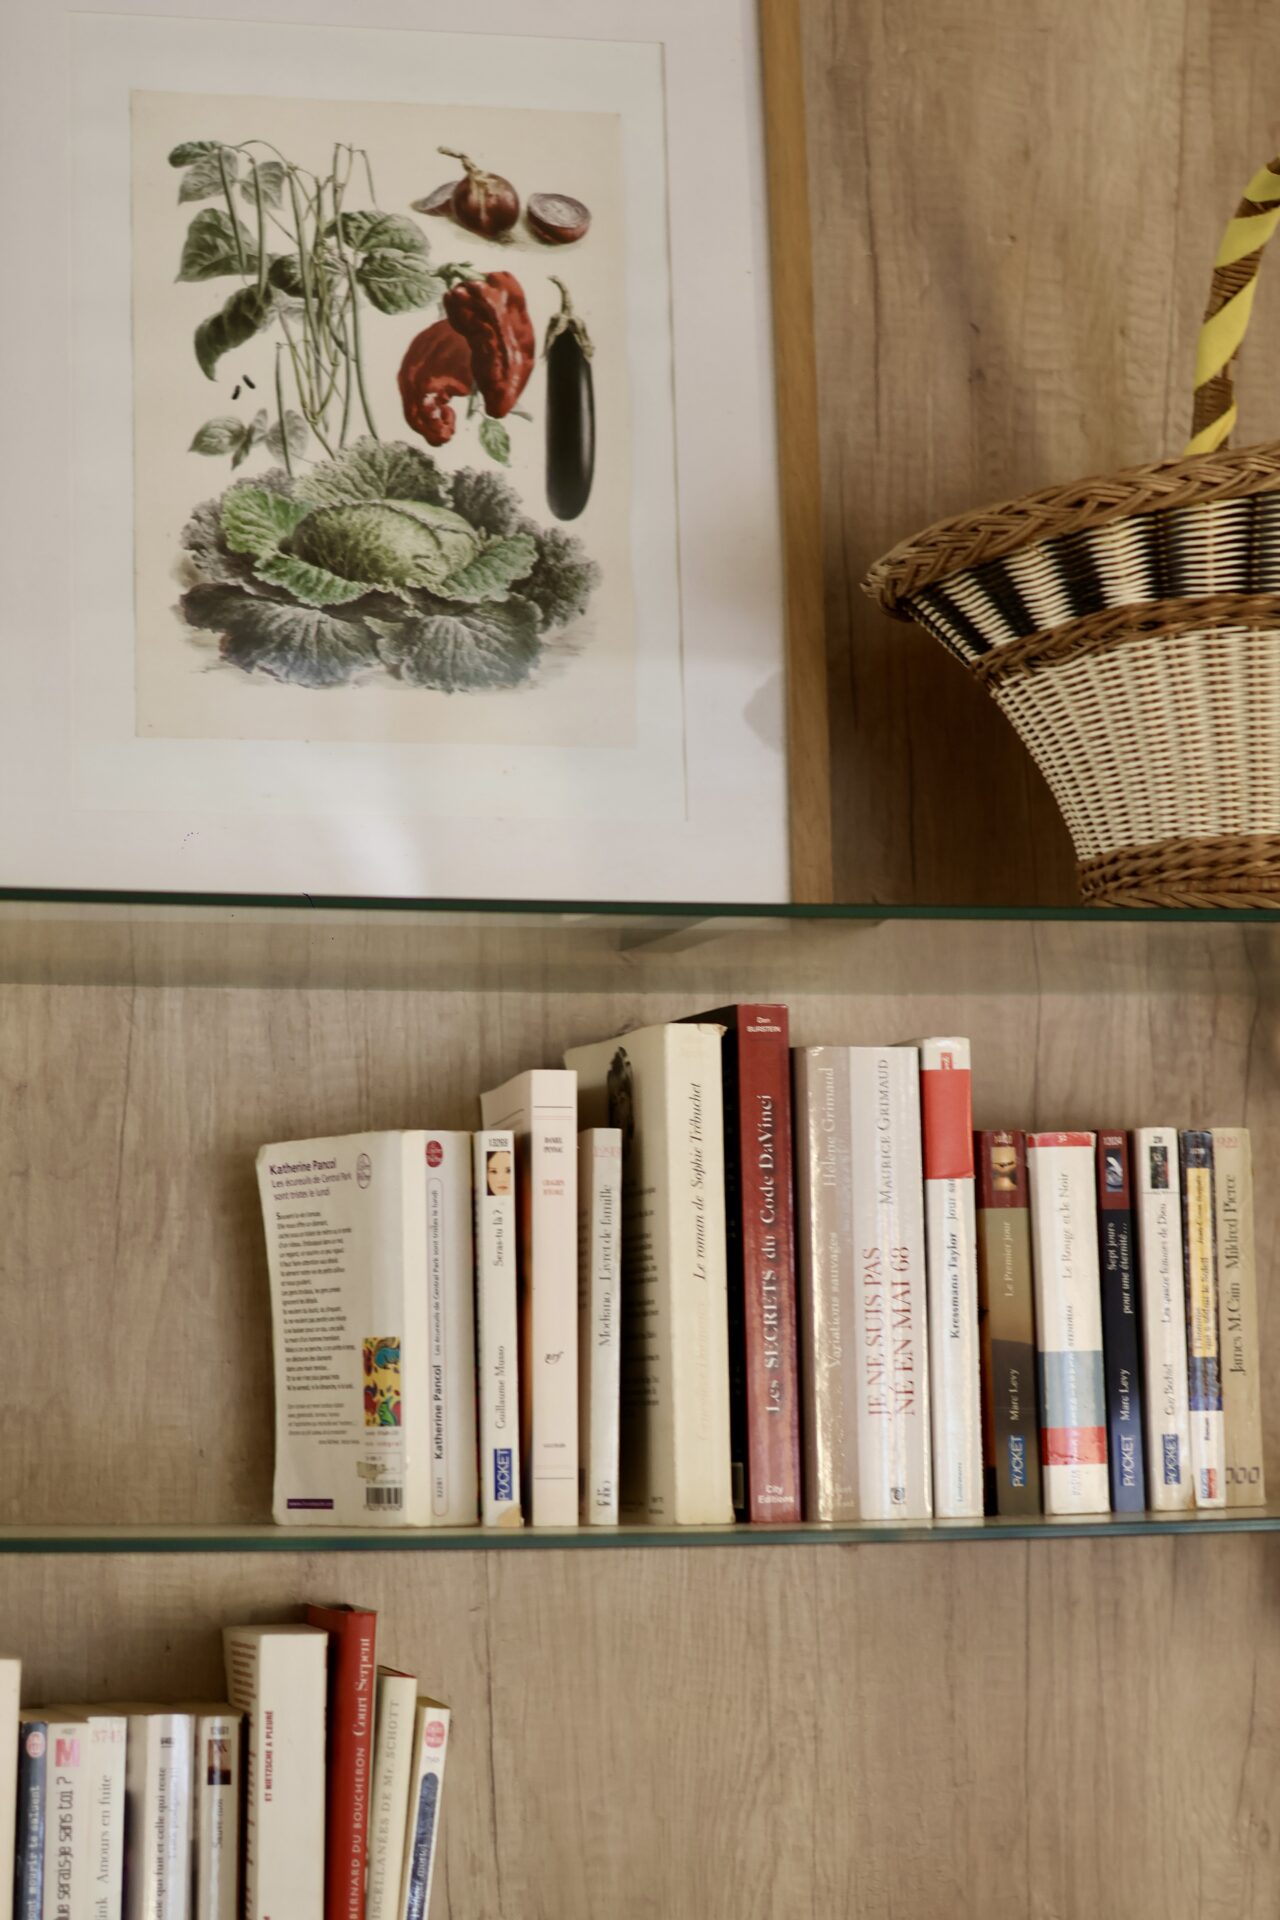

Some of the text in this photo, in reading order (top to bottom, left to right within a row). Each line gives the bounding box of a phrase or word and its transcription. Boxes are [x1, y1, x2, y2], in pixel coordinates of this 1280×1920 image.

[817, 1067, 837, 1187] Hélène Grimaud
[877, 1058, 894, 1206] MAURICE GRIMAUD
[269, 1157, 337, 1176] Katherine Pancol
[271, 1179, 284, 1188] Les
[313, 1176, 321, 1184] de
[322, 1173, 340, 1183] Central
[340, 1172, 352, 1181] Park
[689, 1082, 707, 1281] Le roman de Sophie Trébuchet
[273, 1192, 290, 1201] sont
[290, 1190, 308, 1200] tristes
[316, 1188, 331, 1197] lundi
[431, 1190, 439, 1208] lundi
[1057, 1172, 1070, 1199] Noir
[492, 1216, 503, 1226] là
[946, 1198, 959, 1221] Jour
[1058, 1201, 1071, 1212] le
[1156, 1202, 1168, 1225] Dieu
[1222, 1174, 1240, 1269] Mildred Pierce
[492, 1227, 505, 1267] Seras-tu
[1060, 1230, 1075, 1266] Rouge
[1105, 1222, 1117, 1271] Sept jours
[1157, 1226, 1169, 1239] de
[432, 1242, 440, 1258] sont
[432, 1259, 440, 1273] Park
[598, 1184, 612, 1347] Modiano Livret de famille
[756, 1095, 781, 1413] Les SECRETS du Code DaVinci
[946, 1232, 961, 1269] Taylor
[1002, 1221, 1015, 1297] Le Premier jour
[432, 1274, 440, 1300] Central
[1062, 1267, 1073, 1280] Le
[1120, 1274, 1131, 1291] une
[827, 1231, 842, 1370] Variations sauvages
[950, 1274, 961, 1340] Kressmann
[1122, 1292, 1134, 1314] pour
[863, 1247, 892, 1421] JE NE SUIS PAS
[888, 1246, 915, 1416] NÉ EN MAI 68
[1229, 1336, 1246, 1377] James
[494, 1345, 506, 1429] Guillaume Musso
[1008, 1368, 1021, 1421] Marc Levy
[1118, 1368, 1131, 1421] Marc Levy
[433, 1365, 444, 1460] Katherine Pancol
[496, 1449, 511, 1501] POCKET
[1010, 1435, 1025, 1488] POCKET
[1121, 1435, 1136, 1488] POCKET
[1164, 1434, 1180, 1485] POCKET
[757, 1494, 794, 1504] Editions
[765, 1484, 783, 1495] City
[263, 1710, 274, 1739] PLEURÉ
[55, 1776, 73, 1786] ?
[157, 1766, 167, 1791] reste
[264, 1749, 273, 1790] NIETZSCHE
[350, 1637, 373, 1920] BERNARD DU BOUCHERON Court Serpent
[57, 1789, 74, 1809] toi
[98, 1774, 113, 1806] fuite
[156, 1794, 168, 1814] qui
[264, 1792, 273, 1802] ET
[29, 1785, 41, 1832] saluent
[101, 1810, 111, 1826] en
[368, 1698, 401, 1920] ISCELLANÉES DE Mr. SCHOTT
[28, 1836, 38, 1848] te
[58, 1813, 73, 1842] sans
[154, 1815, 166, 1841] celle
[96, 1831, 112, 1884] Amours
[156, 1842, 165, 1854] et
[27, 1853, 38, 1894] mourir
[56, 1846, 74, 1900] serais-je
[154, 1856, 164, 1876] fuit
